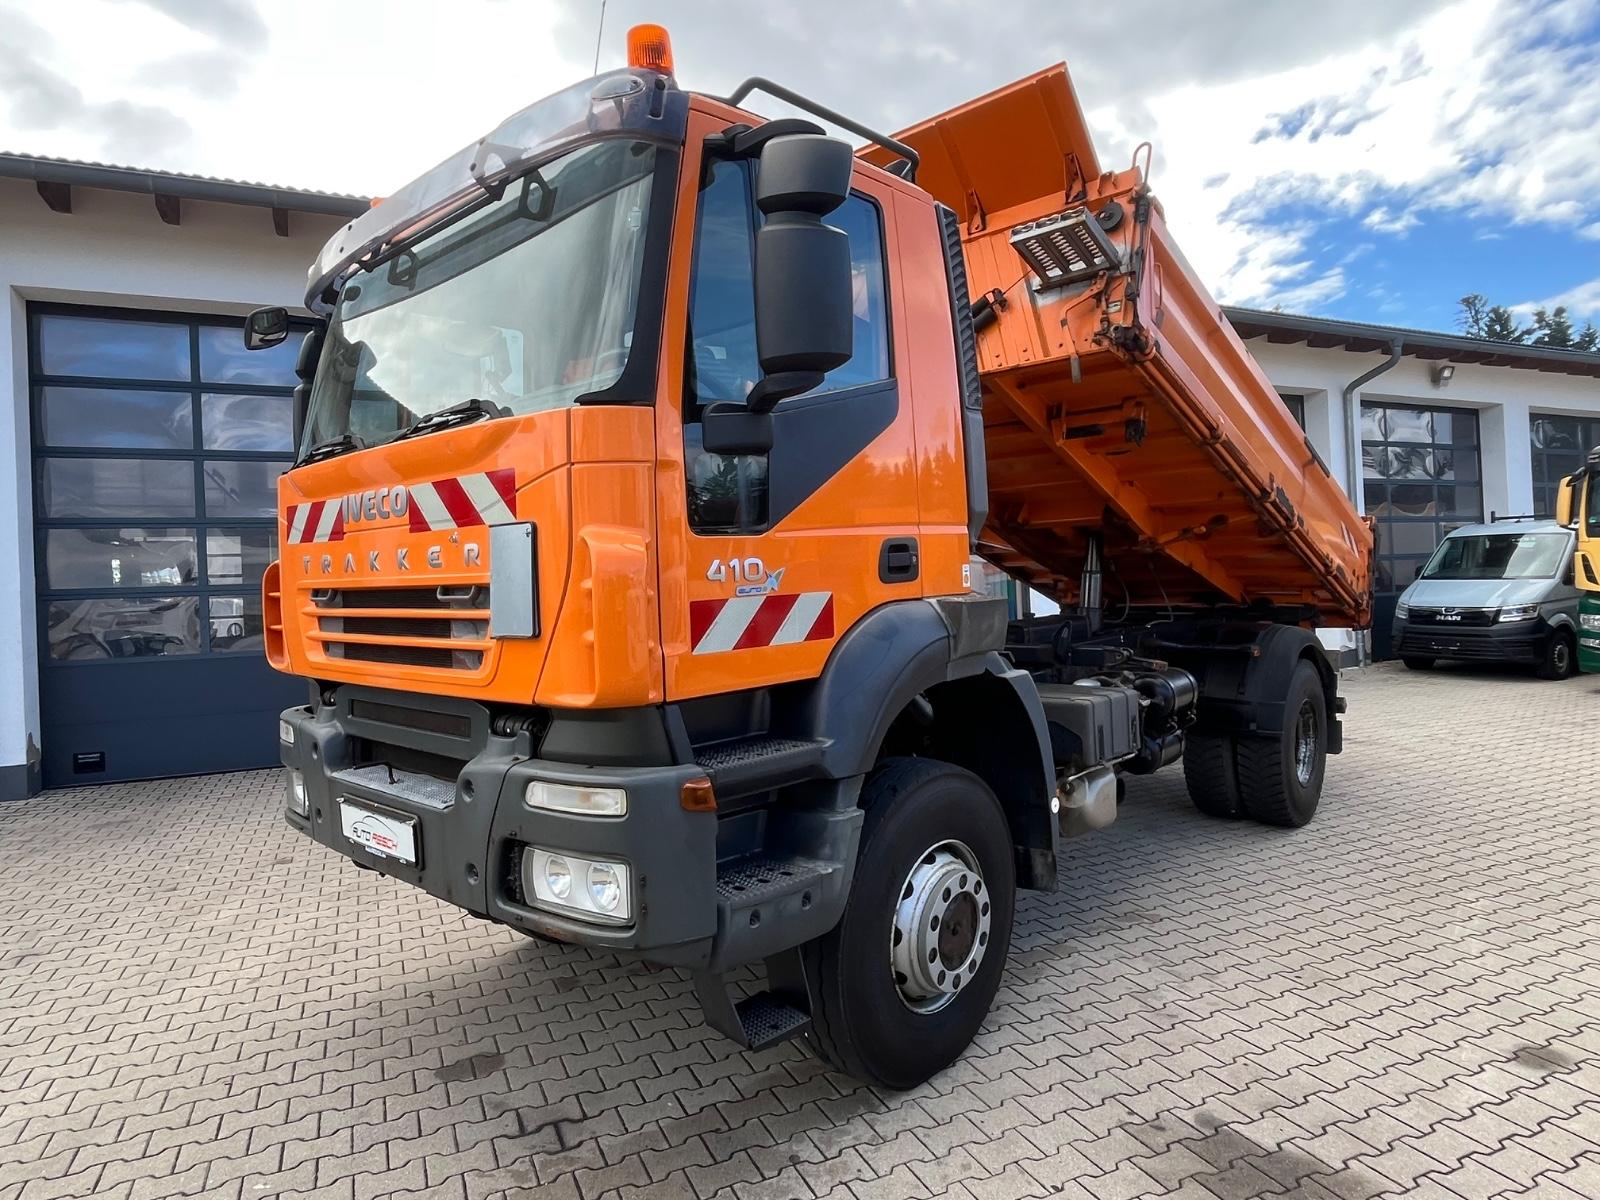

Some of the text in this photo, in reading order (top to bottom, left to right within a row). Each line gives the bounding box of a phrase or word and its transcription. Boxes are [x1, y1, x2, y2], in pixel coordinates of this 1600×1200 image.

[341, 485, 408, 524] IVECO
[303, 543, 481, 574] TRAKKER
[706, 557, 764, 582] 410
[352, 826, 371, 842] AUTO
